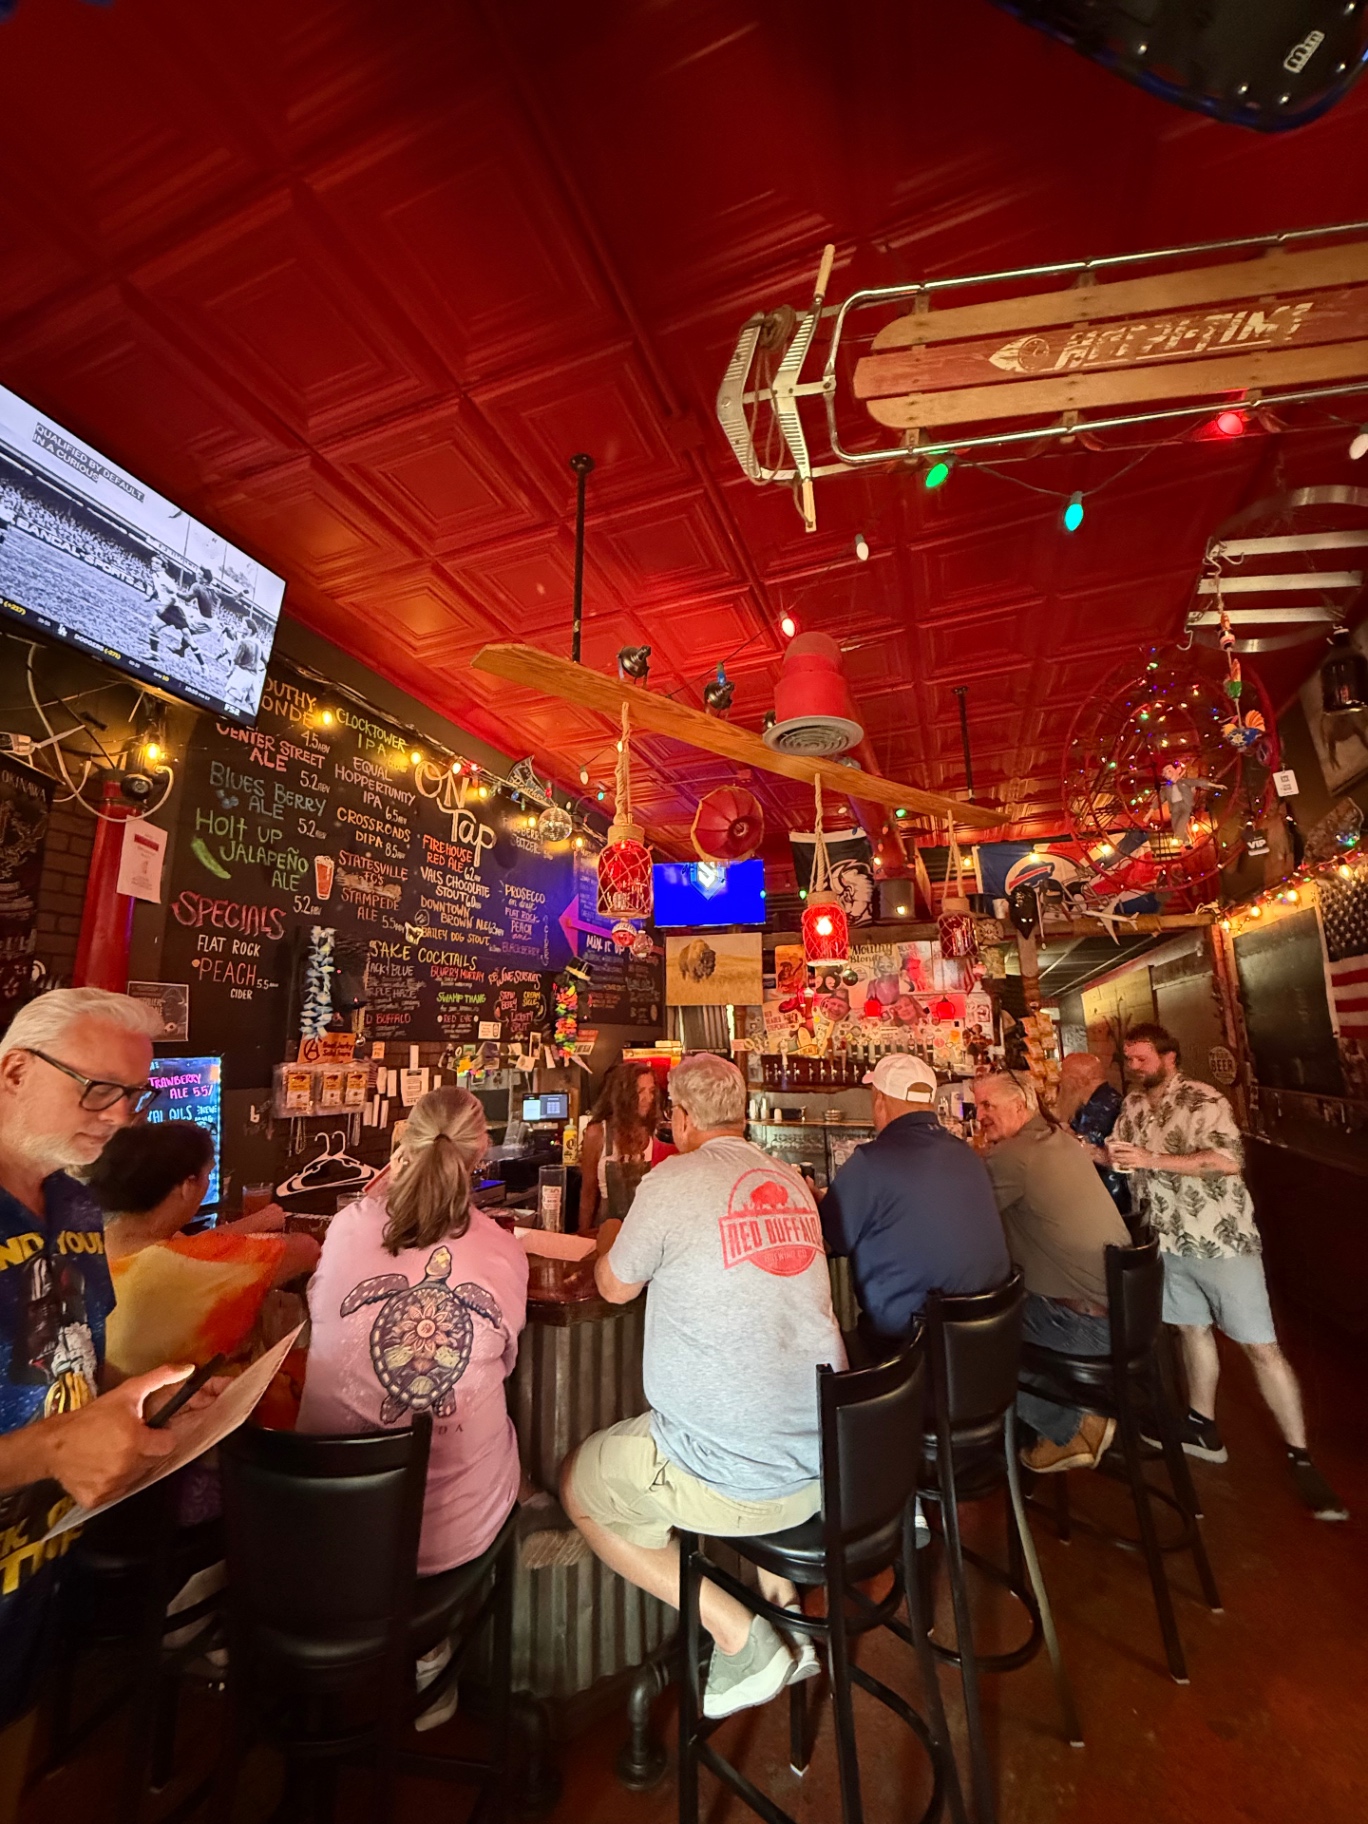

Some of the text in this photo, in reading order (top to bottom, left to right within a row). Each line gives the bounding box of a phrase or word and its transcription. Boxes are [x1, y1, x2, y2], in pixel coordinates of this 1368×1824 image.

[33, 433, 99, 482] IN A CURIOUS
[36, 425, 143, 500] QUALIFIED BY DEFAULT
[265, 677, 317, 712] OUTHY
[261, 695, 315, 730] ONDE
[335, 707, 409, 753] CLOCKTOWER
[280, 740, 326, 769] STREET
[357, 733, 387, 757] IPA
[249, 747, 289, 772] ALE
[353, 757, 393, 782] EQUAL
[2, 770, 46, 801] OKINAWA
[334, 763, 416, 807] HOPPERTUNITY
[415, 760, 470, 809] ON
[248, 795, 285, 821] ALE
[274, 781, 327, 817] BERRY
[363, 790, 383, 810] IPA
[257, 826, 284, 846] UP
[336, 807, 412, 842] CROSSROADS
[436, 797, 498, 868] Tap
[355, 830, 383, 848] DIPA
[422, 833, 474, 863] FIREHOUSE
[1247, 839, 1267, 849] VIP
[338, 849, 409, 881] STATESVILLE
[426, 852, 465, 874] RED ALE
[271, 870, 301, 892] ALE
[420, 866, 491, 899] VALS CHOCOLATE
[435, 885, 467, 901] STOUT
[340, 887, 400, 911] STAMPEDE
[420, 894, 471, 918] DOWNTOWN
[505, 884, 545, 904] PROSECCO
[170, 890, 287, 941] SPECIALS
[357, 907, 379, 923] ALE
[440, 912, 474, 929] BROWN
[197, 934, 261, 957] FLAT ROCK
[422, 925, 491, 946] BAILEY DOG STOUT
[369, 939, 478, 971] SAKE COCKTAILS
[199, 957, 257, 987] PEACH
[370, 962, 385, 975] ACK
[391, 963, 415, 976] BLUE
[230, 988, 253, 1000] CIDER
[148, 1073, 201, 1089] TRAWBERRY
[170, 1087, 188, 1099] ALE
[0, 1232, 45, 1271] ND
[727, 1220, 763, 1259] RED
